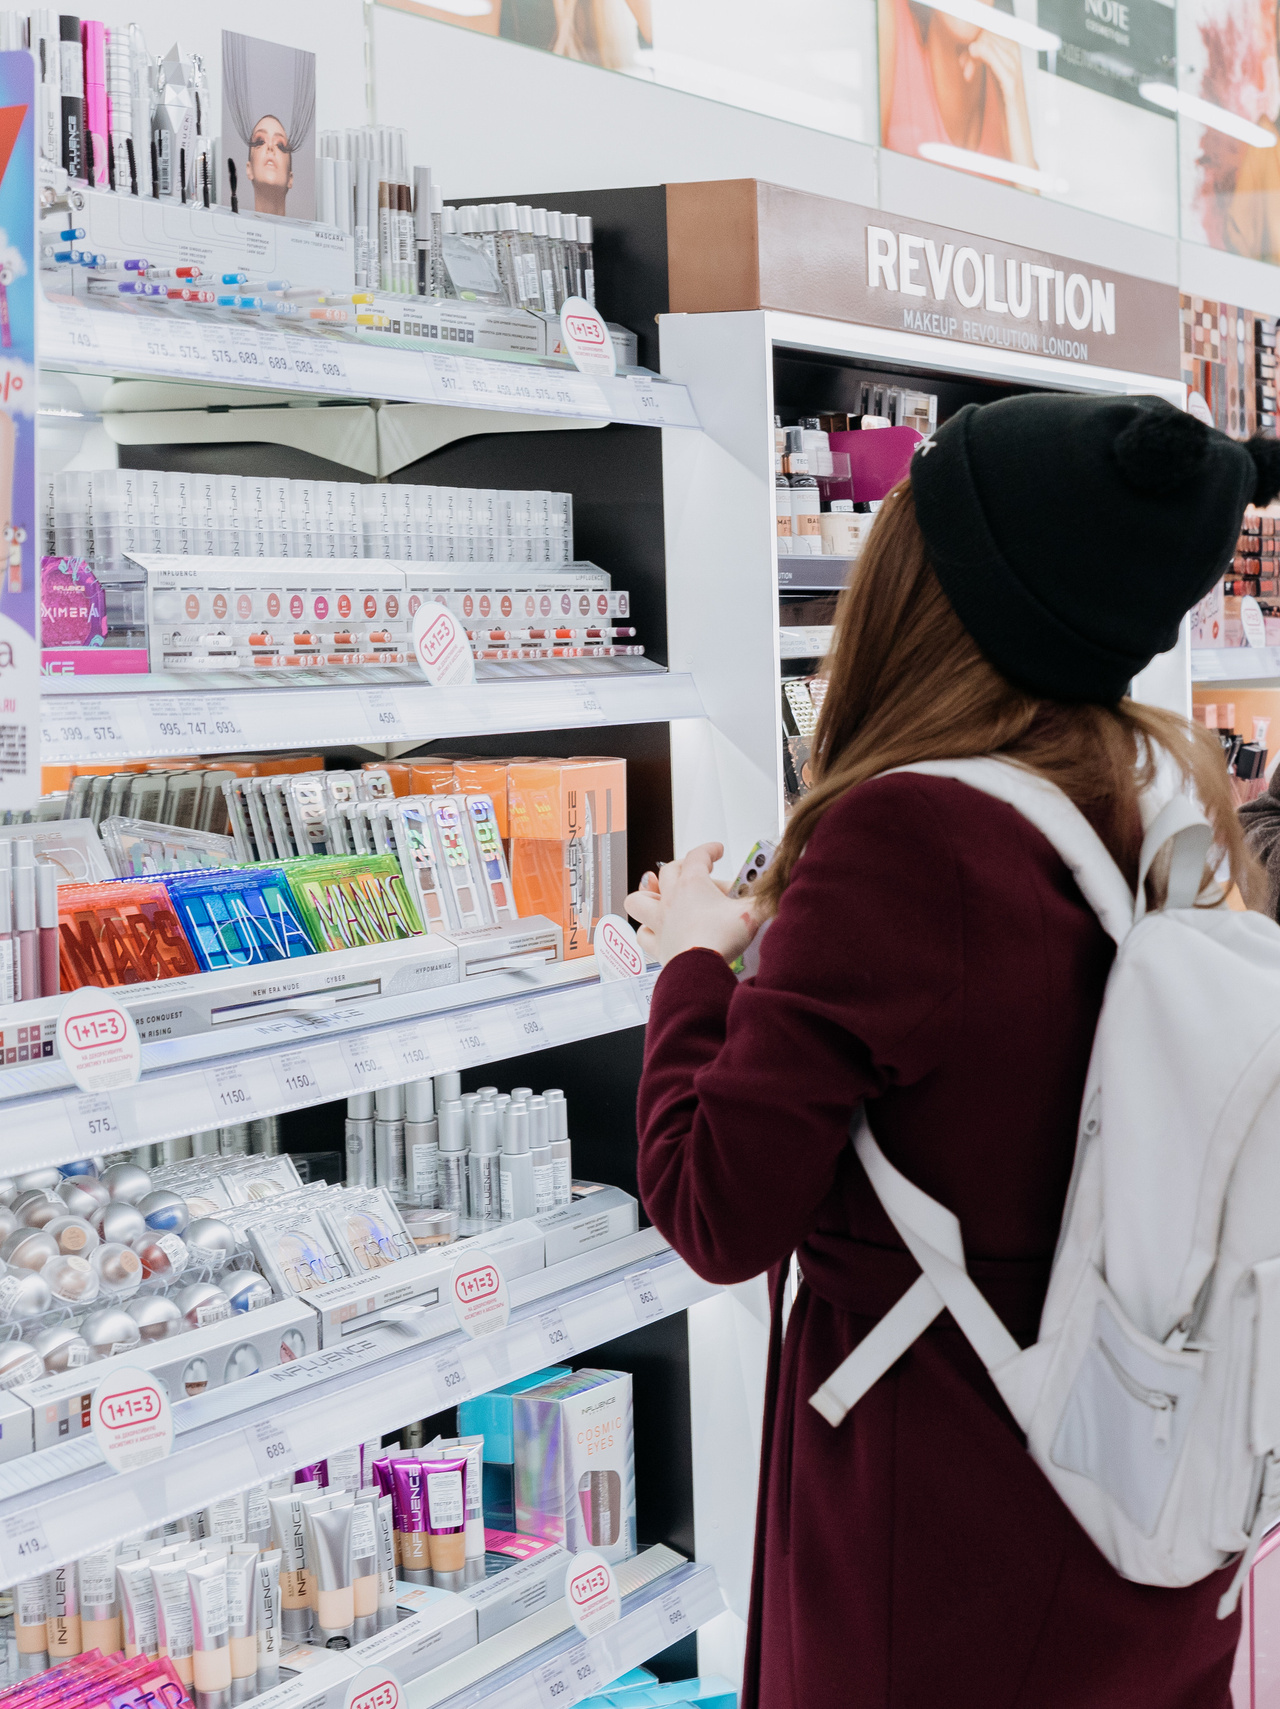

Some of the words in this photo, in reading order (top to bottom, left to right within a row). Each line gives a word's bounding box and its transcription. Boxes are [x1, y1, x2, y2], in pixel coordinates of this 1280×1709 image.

[1085, 0, 1129, 31] NOTE
[68, 115, 77, 178] NFLUENCE
[314, 232, 344, 242] MASCARA
[867, 225, 1116, 335] REVOLUTION
[570, 322, 600, 338] 1+1=3
[903, 308, 957, 338] MAKEUP
[962, 318, 1038, 354] REVOLUTION
[1043, 330, 1088, 360] LONDON
[147, 342, 168, 356] 575
[179, 346, 200, 360] 575
[212, 349, 232, 363] 575
[238, 351, 258, 365] 689
[268, 356, 288, 370] 689
[295, 360, 314, 374] 689
[322, 363, 340, 376] 689
[441, 376, 456, 390] 517
[536, 388, 550, 400] 575
[557, 390, 572, 402] 575
[642, 396, 654, 408] 517
[424, 621, 450, 657] 1+1=3
[584, 700, 596, 711] 459
[378, 712, 395, 724] 459
[61, 728, 83, 741] 399
[94, 727, 115, 740] 575
[160, 723, 181, 736] 995
[188, 722, 206, 735] 747
[216, 721, 236, 734] 693
[568, 791, 578, 950] INFLUENCE
[212, 882, 258, 892] INFLUENCE
[186, 893, 317, 970] LUNA
[58, 909, 194, 987] MARS
[608, 930, 637, 968] 1+1=3
[416, 963, 452, 974] HYPOMANIAC
[326, 974, 346, 984] CYBER
[112, 986, 148, 996] YESHADOW
[152, 981, 187, 990] PALETTES
[252, 988, 266, 996] NEW
[269, 986, 282, 994] ERA
[282, 983, 300, 992] NUDE
[146, 1011, 182, 1024] CONQUEST
[255, 1008, 364, 1035] INFLUENCE
[73, 1018, 119, 1042] 1+1=3
[148, 1028, 172, 1038] RISING
[523, 1022, 539, 1035] 689
[459, 1036, 481, 1050] 1150
[402, 1049, 424, 1065] 1150
[354, 1058, 377, 1075] 1150
[286, 1075, 310, 1091] 1150
[220, 1089, 246, 1106] 1150
[88, 1118, 111, 1134] 575
[244, 1164, 281, 1179] INFLUENCE
[181, 1183, 214, 1196] FLUENCE
[484, 1163, 492, 1219] NFLUENCE
[343, 1196, 380, 1212] INFLUENCE
[273, 1215, 312, 1232] INFLUENCE
[353, 1230, 418, 1271] CARCASS
[284, 1251, 351, 1294] CARCASS
[354, 1274, 381, 1287] CARCASS
[460, 1272, 494, 1296] 1+1=3
[640, 1291, 654, 1304] 863
[549, 1330, 564, 1344] 829
[270, 1340, 376, 1382] INFLUENCE
[444, 1372, 461, 1388] 829
[108, 1395, 154, 1421] 1+1=3
[582, 1396, 616, 1415] INFLUENCE
[577, 1416, 622, 1444] COSMIC
[266, 1442, 286, 1458] 689
[587, 1435, 614, 1456] EYES
[408, 1467, 424, 1558] INFLUENCE
[18, 1538, 40, 1557] 419
[290, 1501, 307, 1597] INFLUENCE
[379, 1513, 395, 1593] INFLUENCE
[576, 1572, 605, 1598] 1+1=3
[56, 1568, 68, 1645] INFLUEN
[260, 1566, 274, 1653] INFLUENCE
[669, 1610, 682, 1624] 699
[577, 1664, 592, 1680] 829
[550, 1681, 565, 1697] 829
